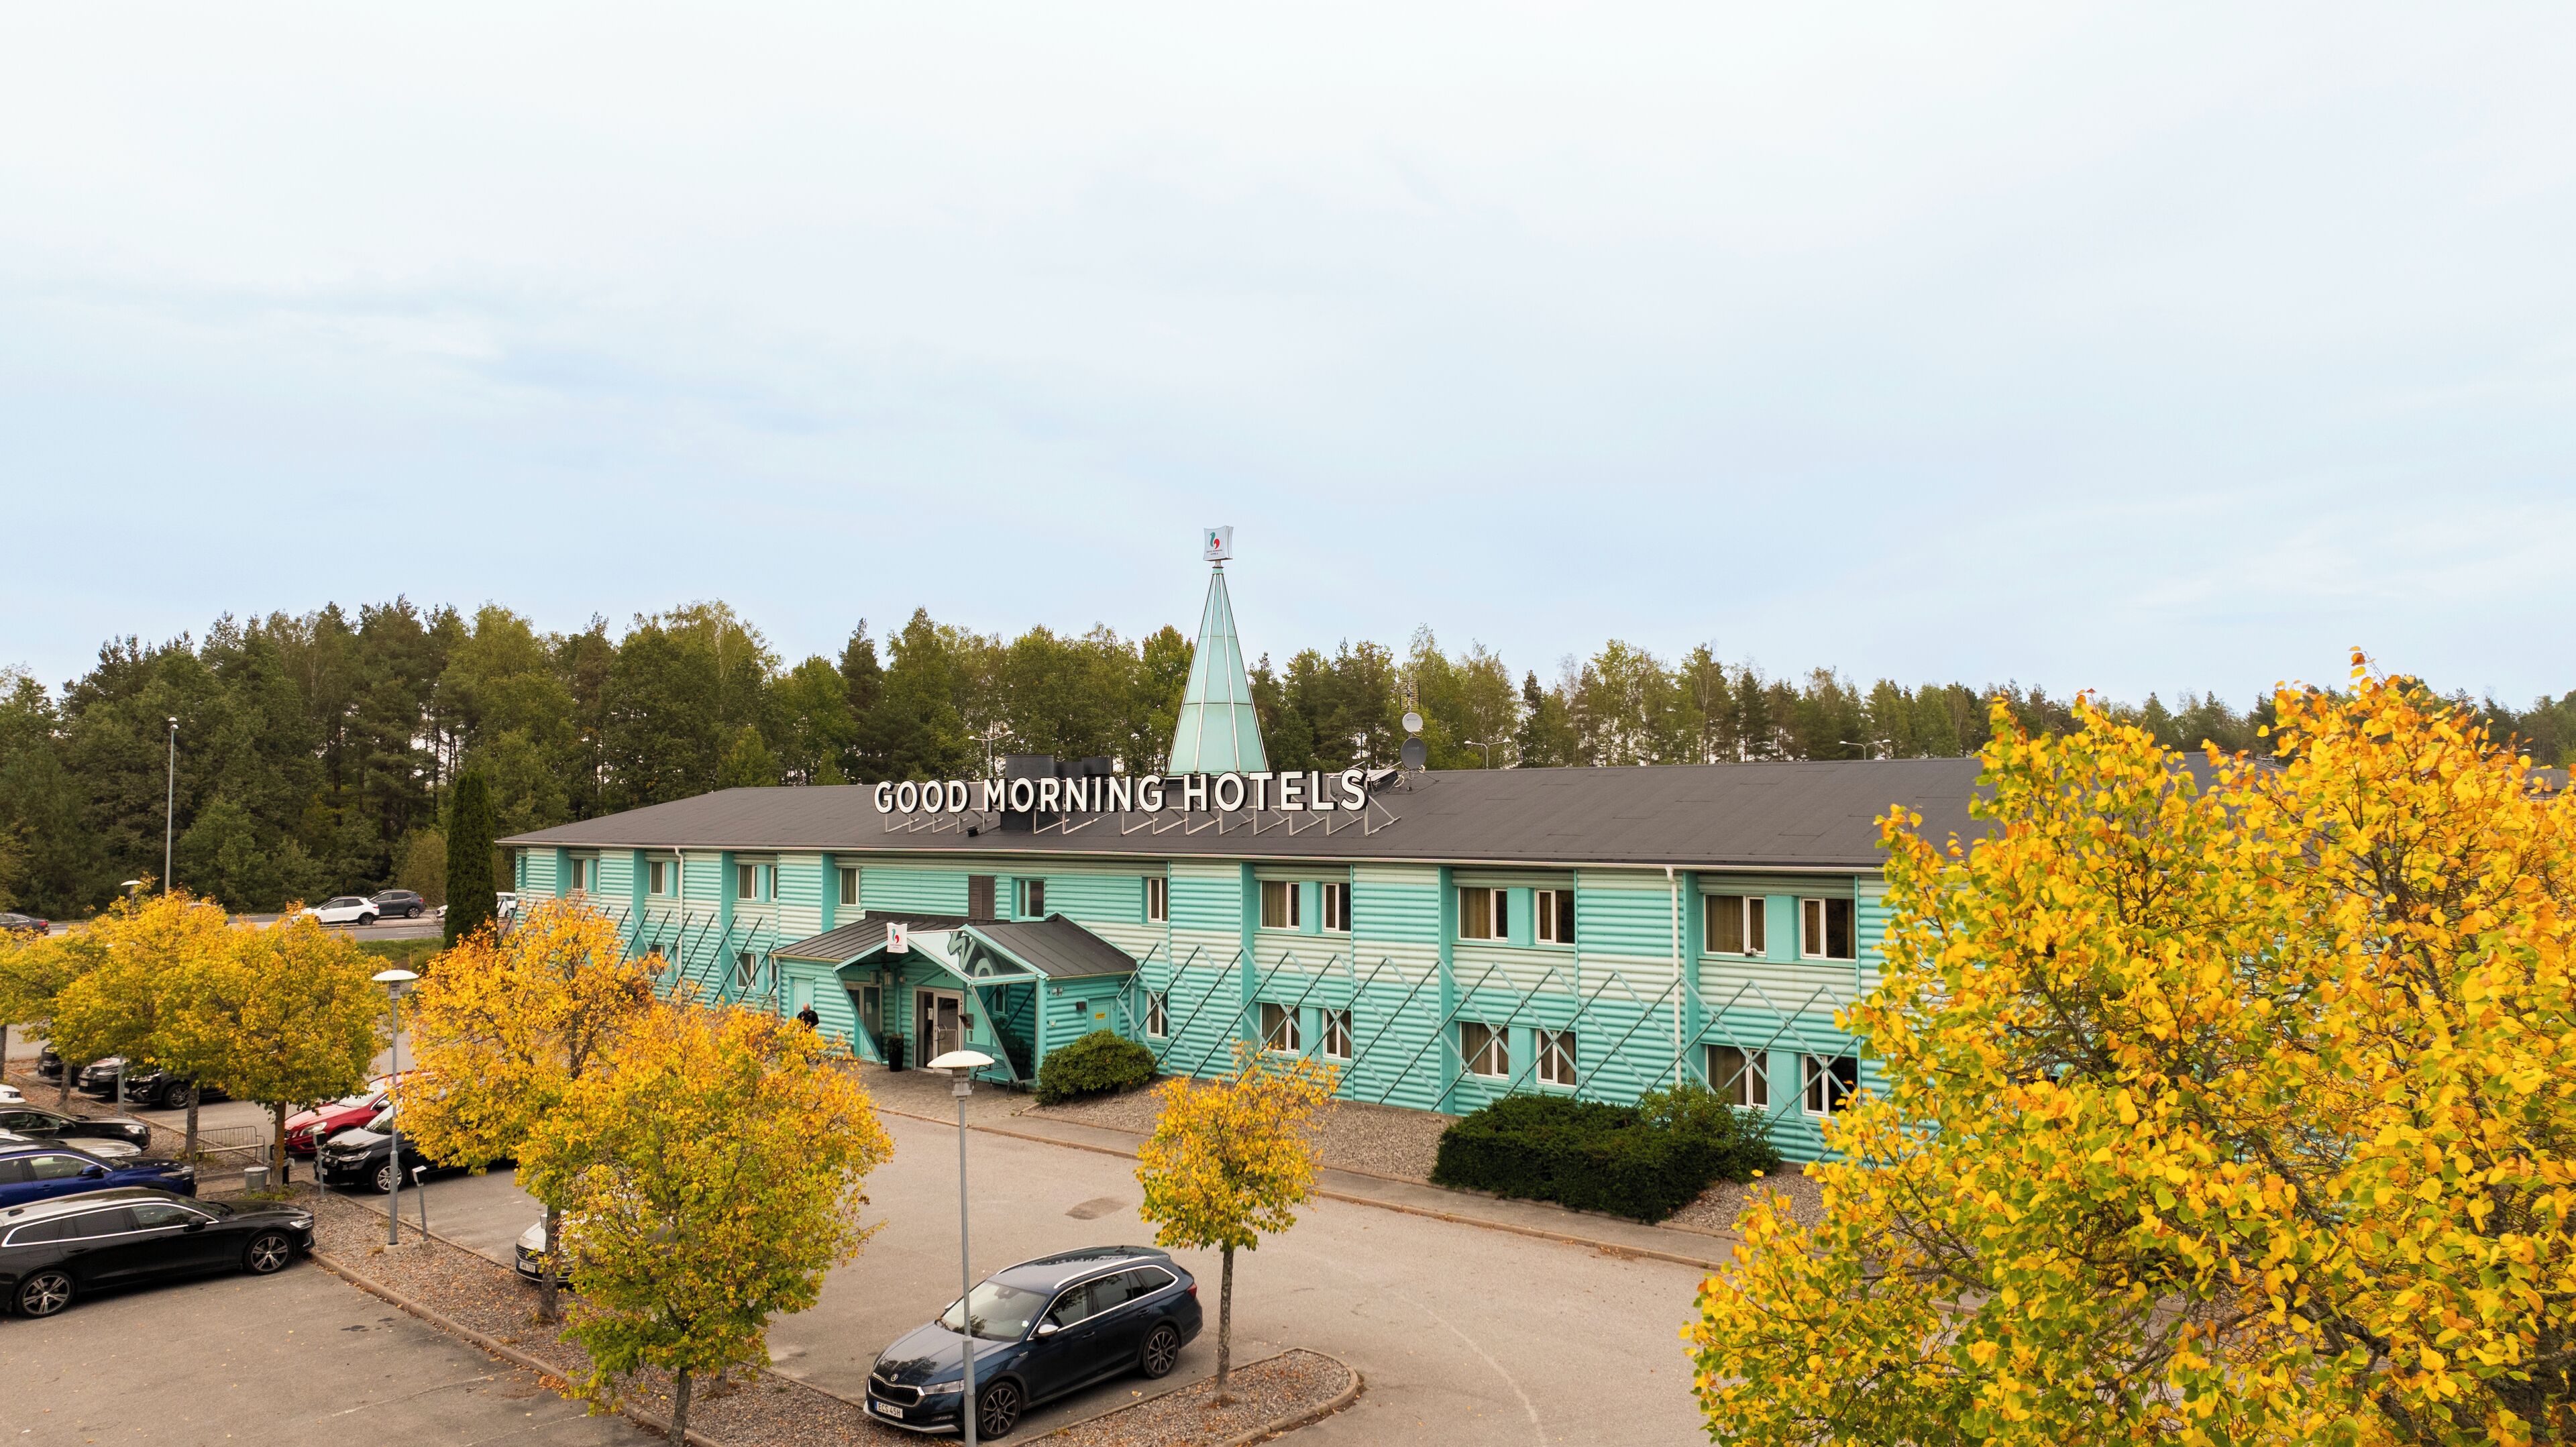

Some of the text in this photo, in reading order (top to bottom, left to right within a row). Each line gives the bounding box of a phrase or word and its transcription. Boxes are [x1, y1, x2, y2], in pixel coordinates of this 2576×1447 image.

[874, 768, 1369, 814] GOOD MORNING HOTELS
[878, 1403, 900, 1417] ECS 45H
